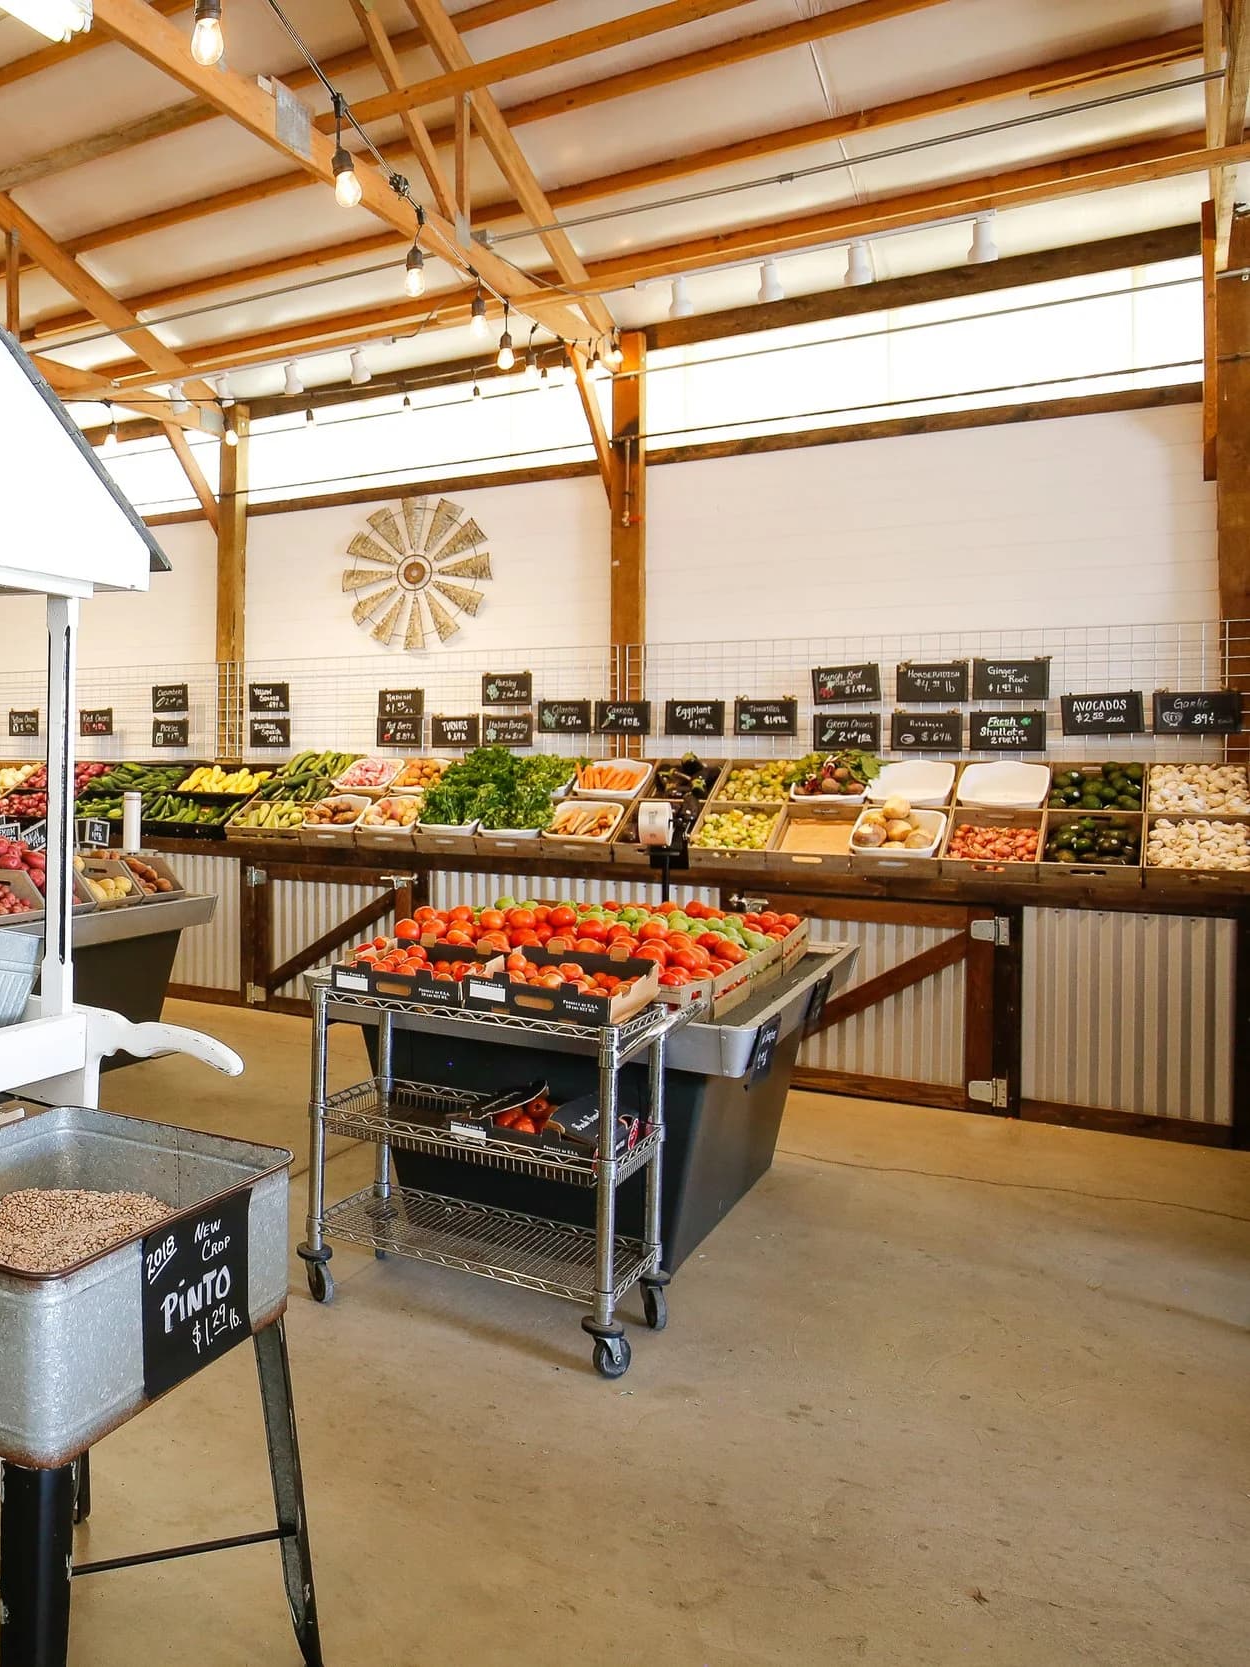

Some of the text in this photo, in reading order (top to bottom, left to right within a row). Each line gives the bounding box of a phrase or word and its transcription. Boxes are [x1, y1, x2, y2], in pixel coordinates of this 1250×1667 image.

[819, 670, 862, 682] Bunch Red
[907, 669, 960, 679] HORSERADISH
[987, 666, 1017, 678] Ginger
[1008, 674, 1029, 683] Root
[495, 679, 517, 690] Parsley
[946, 680, 955, 693] lb
[1073, 699, 1127, 712] AVOCADOS
[1173, 697, 1210, 710] Garlic
[676, 705, 711, 720] Eggplant
[980, 726, 1024, 737] Shallots
[146, 1218, 221, 1281] 2018 NEW
[201, 1235, 231, 1262] CROP
[192, 1304, 228, 1354] $1.29
